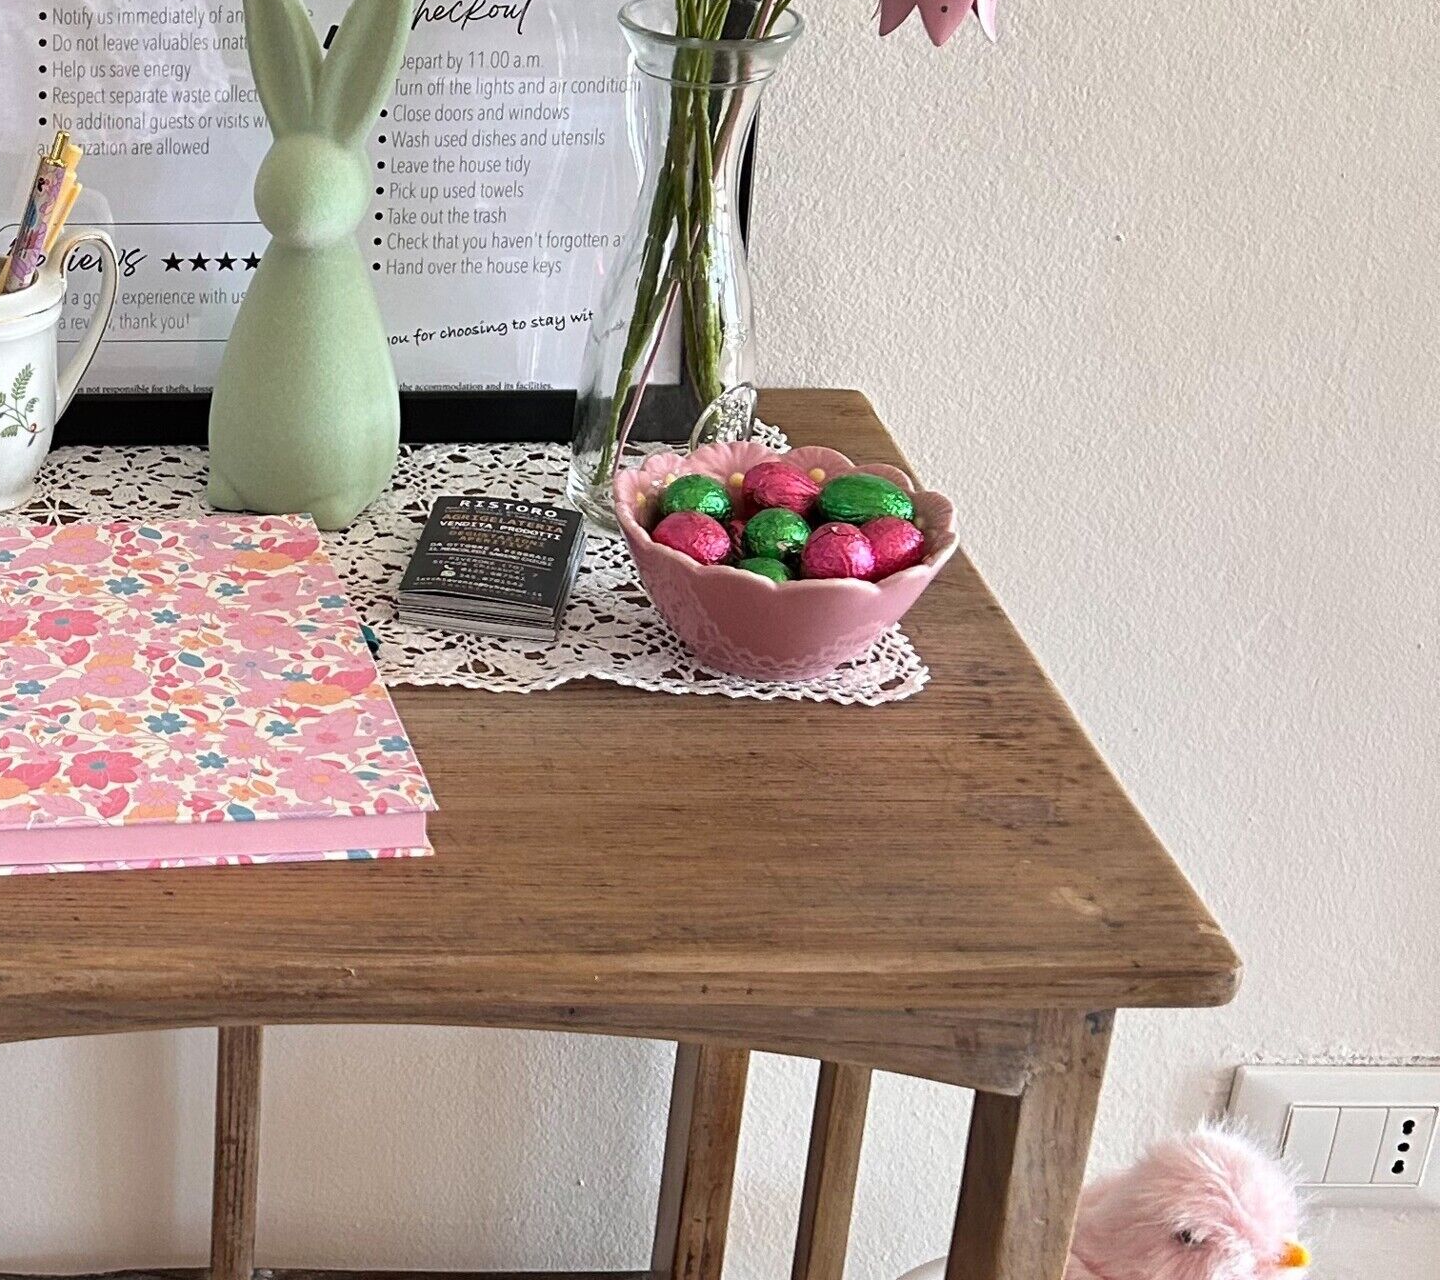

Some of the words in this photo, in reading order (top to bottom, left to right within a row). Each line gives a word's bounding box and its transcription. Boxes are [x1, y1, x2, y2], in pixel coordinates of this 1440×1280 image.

[51, 59, 87, 83] Help
[89, 64, 107, 79] us
[108, 63, 141, 79] save
[143, 63, 192, 83] energy
[392, 104, 432, 123] Close
[434, 104, 474, 122] doors
[476, 104, 505, 122] and
[507, 104, 571, 121] windows
[390, 155, 430, 175] Leave
[432, 155, 456, 174] the
[458, 155, 503, 174] house
[504, 155, 532, 177] tidy
[388, 181, 417, 200] Pick
[419, 185, 440, 203] up
[442, 180, 477, 200] used
[479, 180, 525, 199] towels
[385, 257, 424, 276] Hand
[426, 261, 457, 275] over
[459, 257, 483, 275] the
[485, 257, 530, 275] house
[532, 257, 563, 279] keys
[412, 328, 438, 347] for
[438, 321, 509, 339] choosing
[511, 317, 527, 330] to
[529, 313, 567, 332] stay
[459, 500, 558, 518] RISTORO
[439, 520, 493, 530] VENDITA
[499, 525, 562, 541] PRODOTTI
